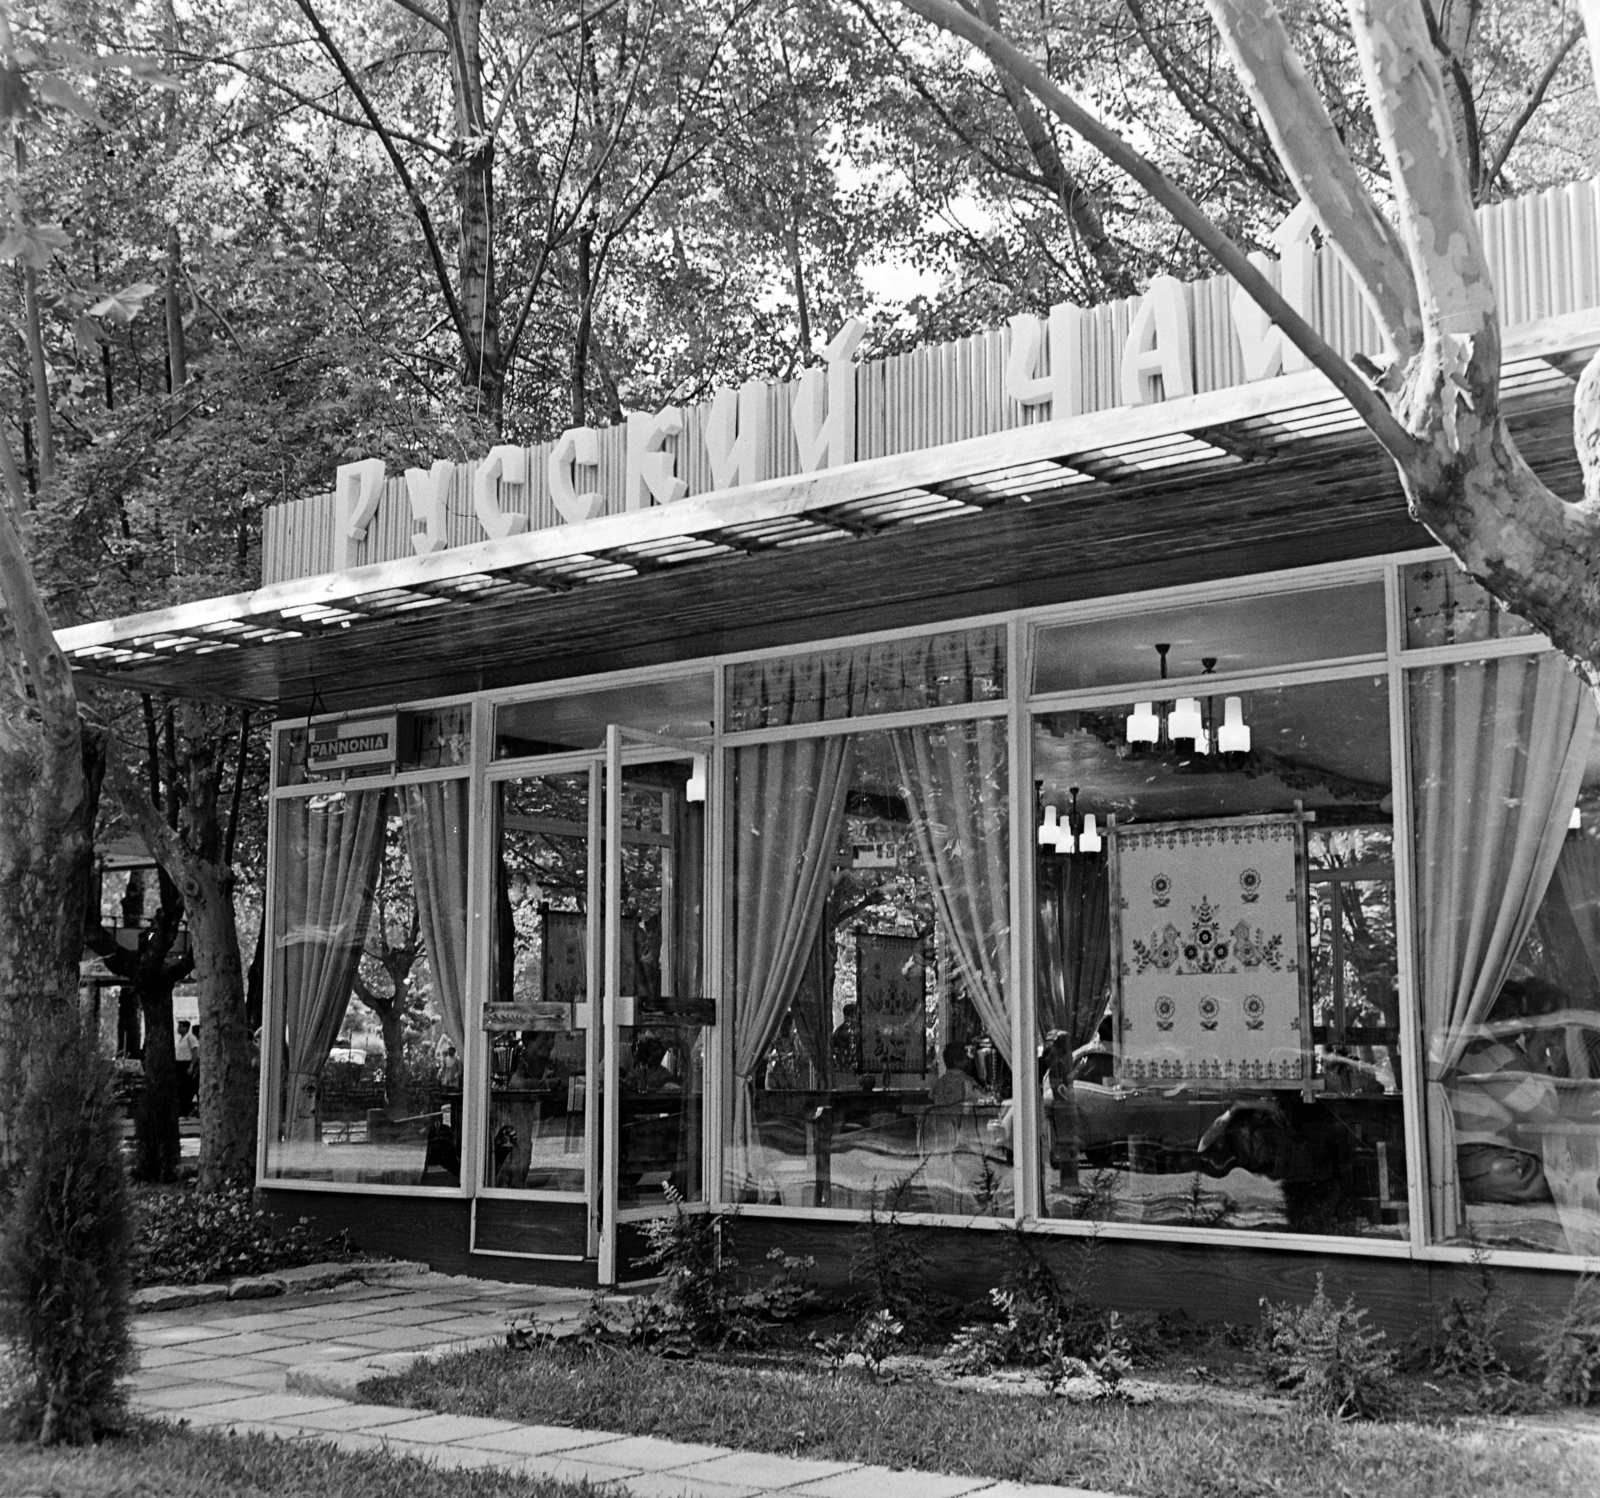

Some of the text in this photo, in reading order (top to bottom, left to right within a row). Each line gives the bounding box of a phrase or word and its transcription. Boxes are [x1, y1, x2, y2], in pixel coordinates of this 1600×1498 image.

[334, 201, 1318, 570] РУССКИЙ ЧАЙ
[310, 736, 384, 757] PANNONIA
